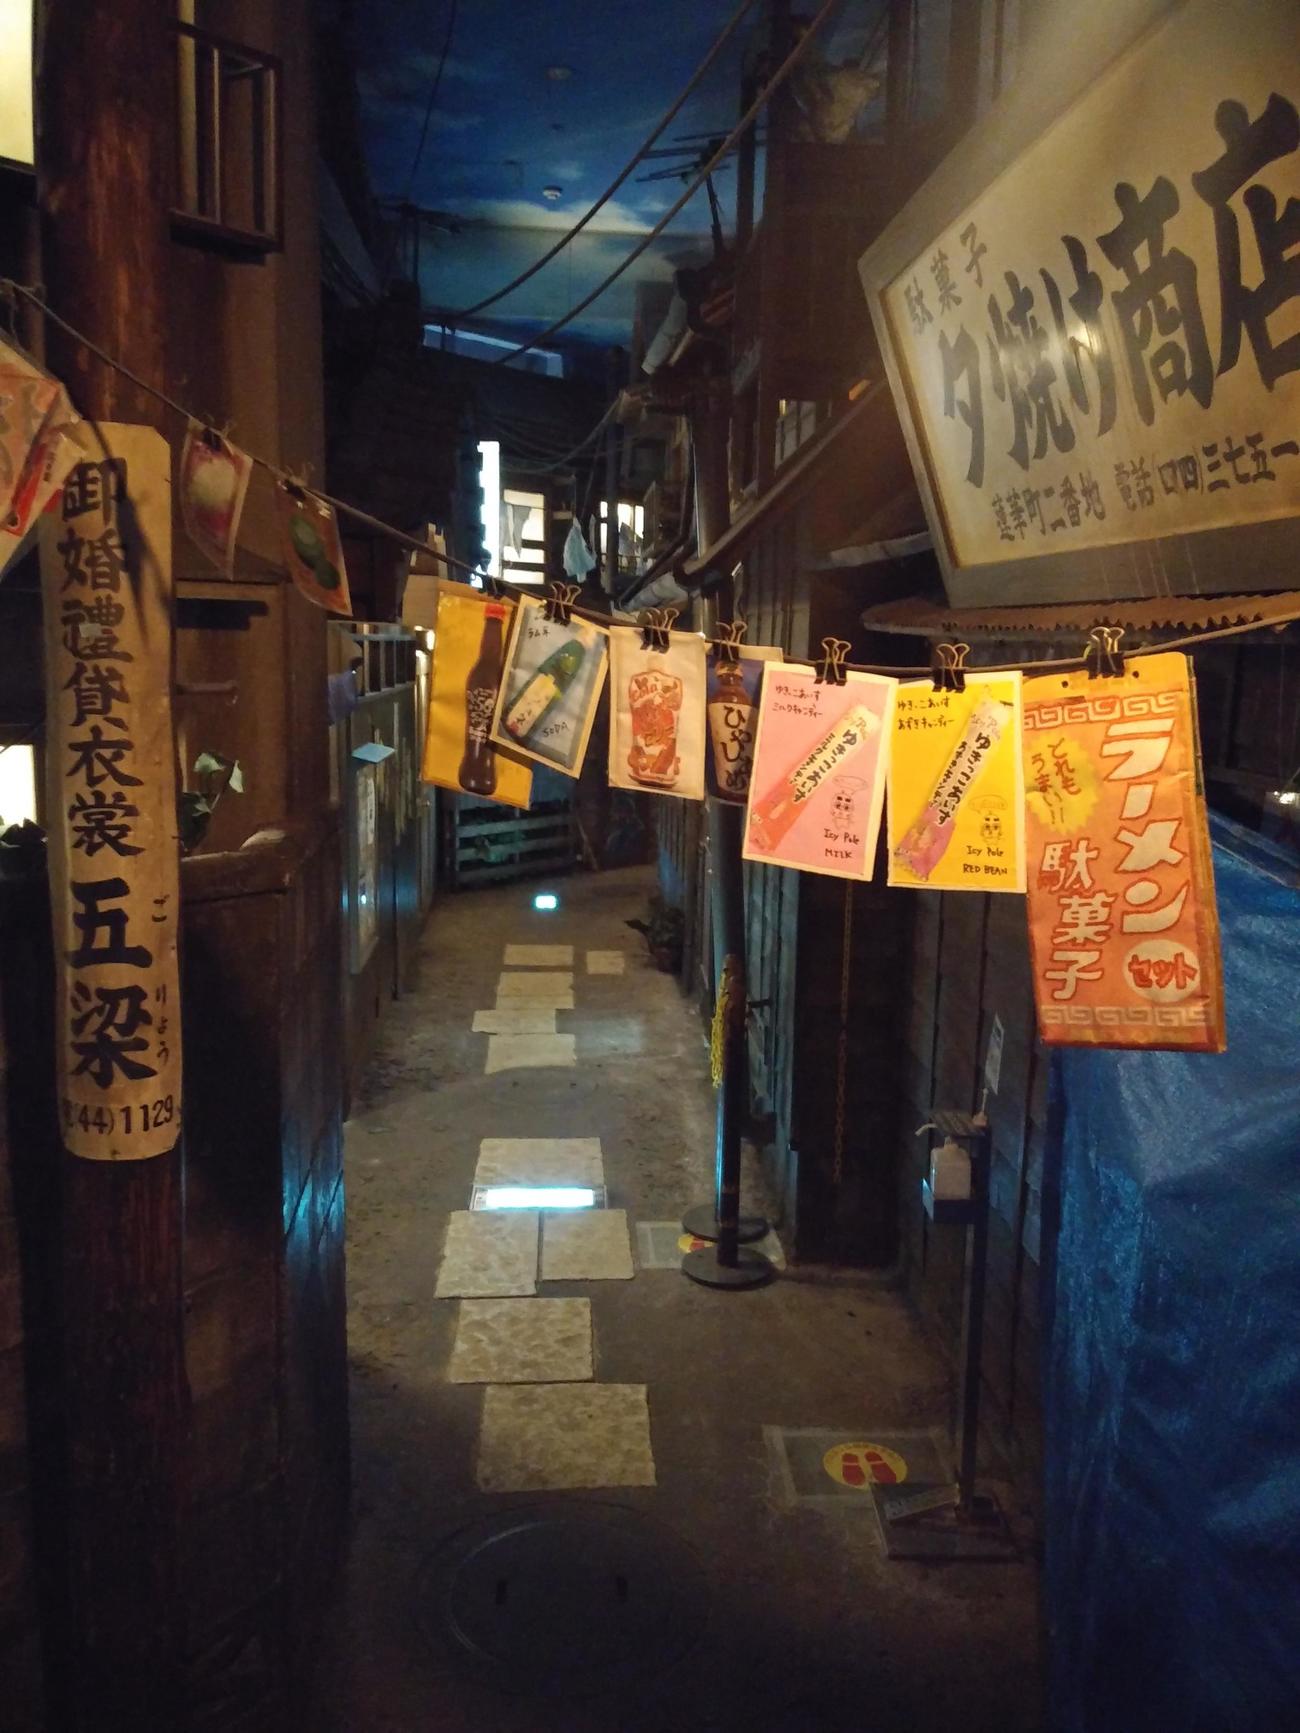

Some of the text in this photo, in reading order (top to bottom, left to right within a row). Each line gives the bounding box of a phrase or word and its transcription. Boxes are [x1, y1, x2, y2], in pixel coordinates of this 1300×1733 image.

[903, 221, 987, 338] 駄菓子
[824, 847, 854, 859] MILK
[1101, 718, 1189, 935] ラーメン
[962, 863, 1008, 875] RED BEAN
[1037, 840, 1116, 1000] 駄菓子
[1127, 950, 1198, 991] セット
